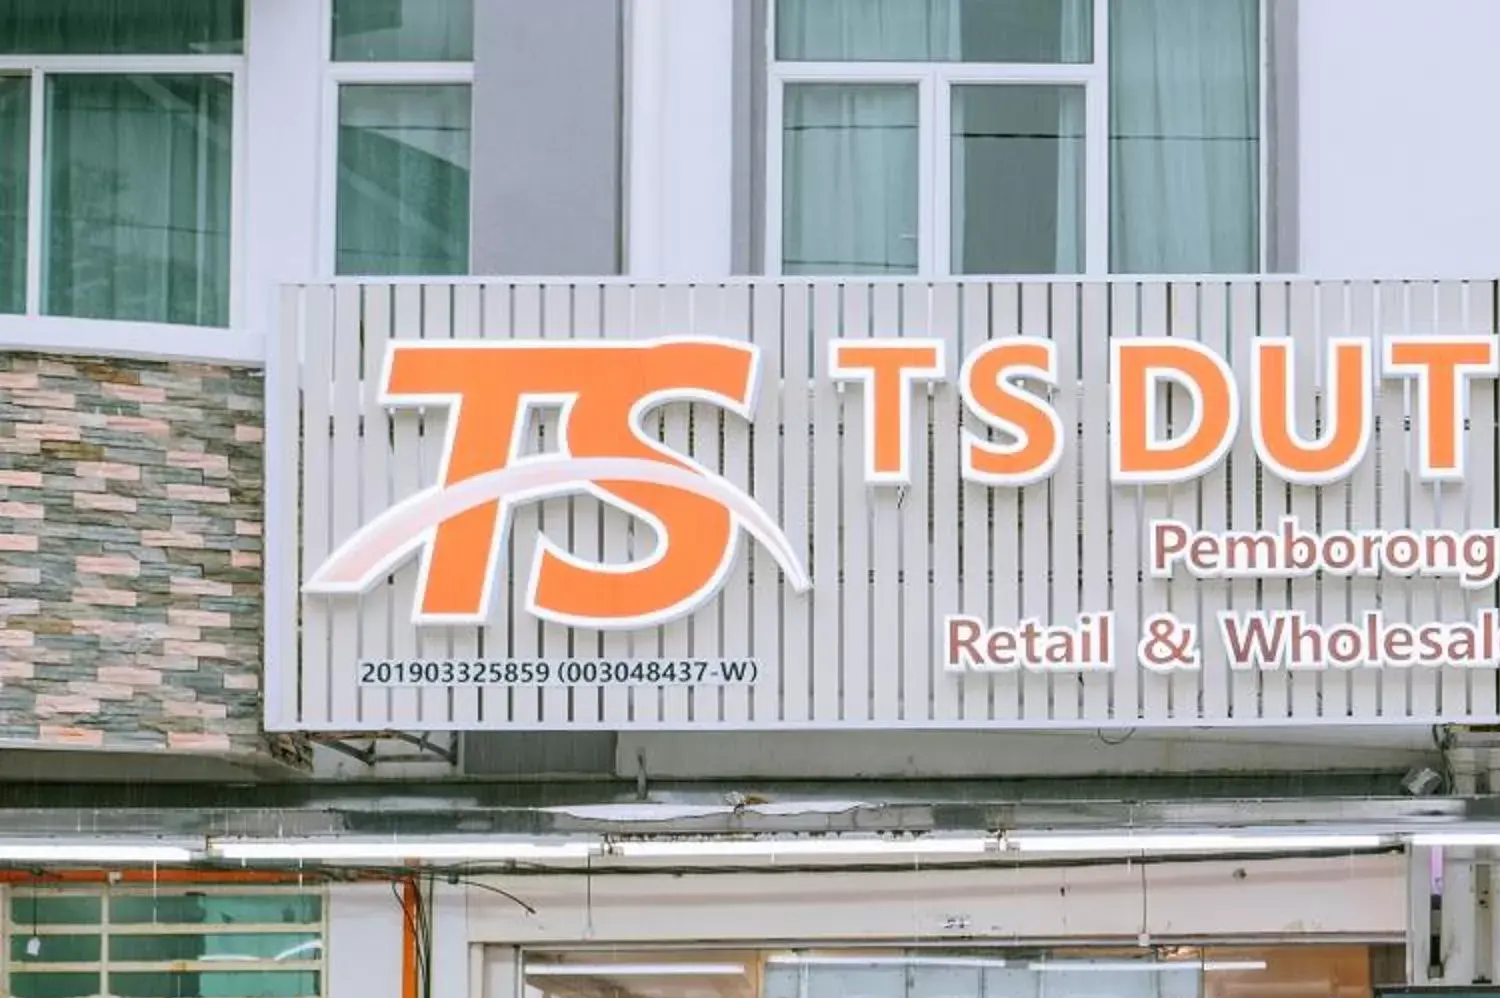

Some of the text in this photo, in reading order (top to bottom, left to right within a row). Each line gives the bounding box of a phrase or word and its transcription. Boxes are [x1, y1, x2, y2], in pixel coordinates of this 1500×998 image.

[834, 340, 1062, 477] TS
[385, 339, 757, 622] TS
[1153, 520, 1497, 583] Pemborong
[947, 615, 1111, 665] Retail
[1142, 618, 1197, 666] &
[361, 659, 760, 688] 201903325859 (003048437-W)
